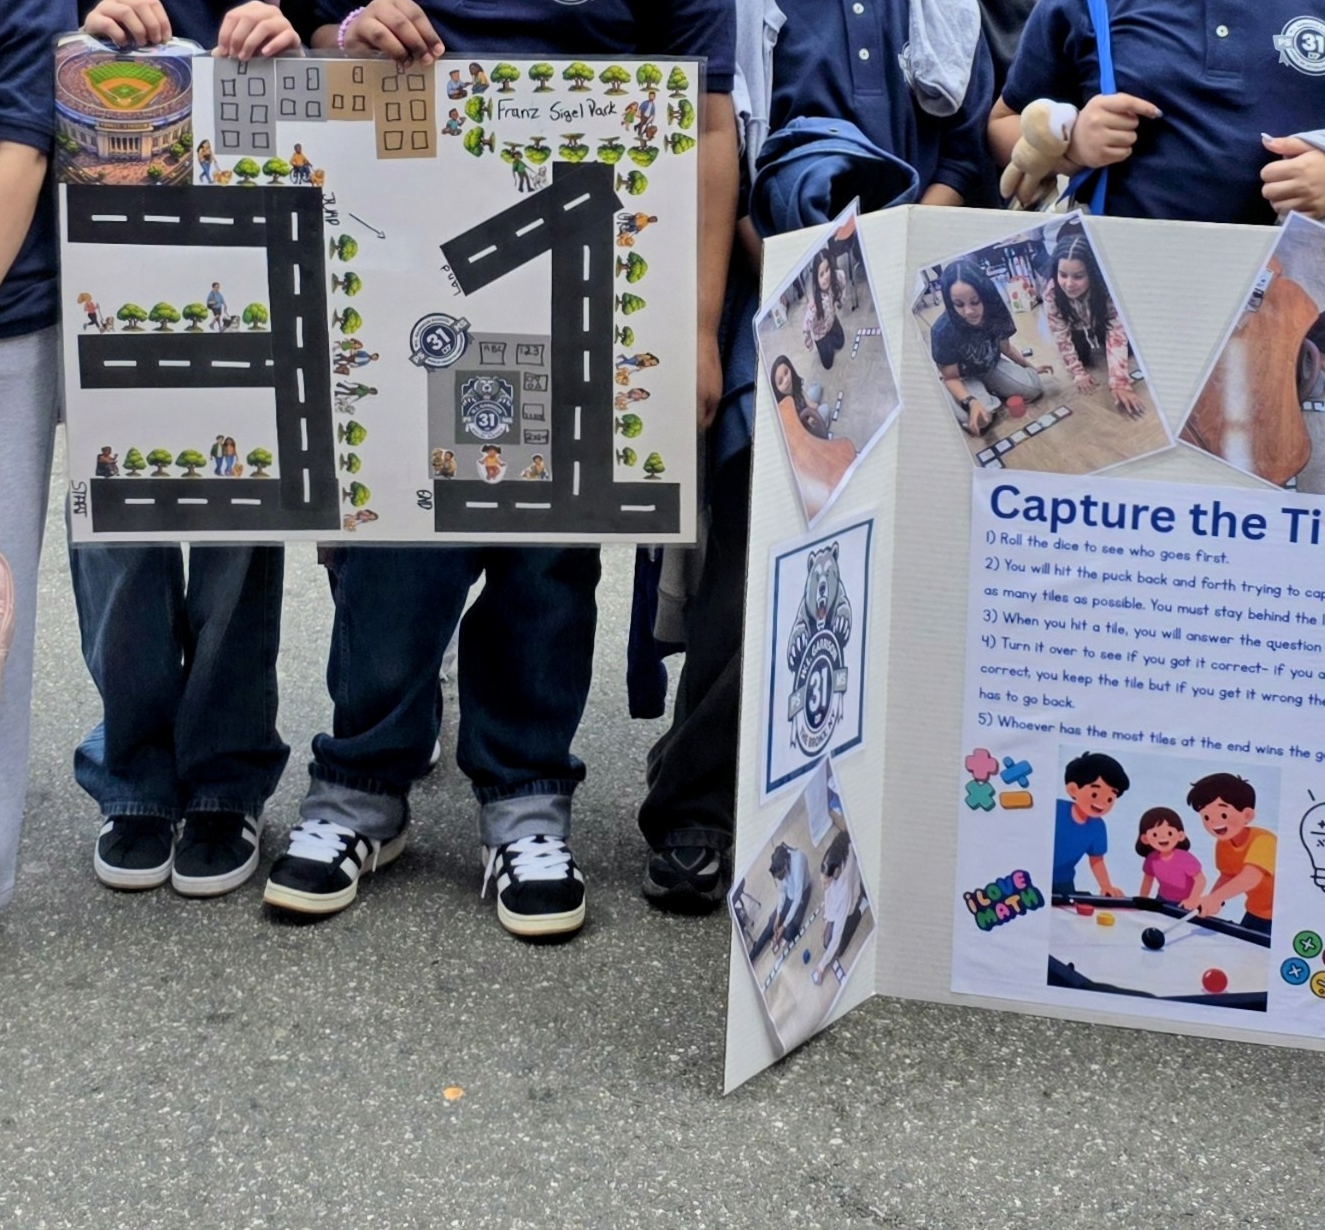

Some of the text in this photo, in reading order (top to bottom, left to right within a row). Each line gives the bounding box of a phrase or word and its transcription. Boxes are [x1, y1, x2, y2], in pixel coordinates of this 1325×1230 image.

[1301, 32, 1325, 54] 31
[497, 98, 618, 123] Franz Sigel Park
[440, 263, 462, 297] Land
[426, 327, 451, 351] 31
[483, 344, 503, 354] ABC
[520, 345, 540, 356] 123
[478, 413, 495, 427] 31
[990, 484, 1176, 533] Capture
[1188, 500, 1267, 541] the
[986, 529, 1229, 564] 1) Roll the dice to see who goes first.
[985, 556, 1000, 571] 2)
[1004, 558, 1026, 572] You
[1030, 562, 1050, 574] will
[1054, 563, 1072, 576] hit
[1076, 566, 1098, 580] the
[1102, 569, 1132, 583] puck
[1137, 570, 1167, 585] back
[1172, 575, 1196, 588] and
[1201, 576, 1236, 591] forth
[1240, 580, 1282, 598] trying
[1286, 584, 1300, 597] to
[983, 587, 998, 596] as
[1002, 589, 1037, 603] many
[1042, 589, 1069, 603] tiles
[1073, 596, 1088, 605] as
[1091, 596, 1145, 610] possible.
[1150, 598, 1172, 612] You
[1176, 604, 1210, 616] must
[1214, 605, 1243, 622] stay
[1247, 607, 1290, 623] behind
[1294, 611, 1317, 625] the
[982, 608, 1322, 652] 3) When you hit a tile, you will answer the question
[811, 638, 838, 662] GARRISON
[981, 634, 996, 649] 4)
[1000, 636, 1030, 651] Turn
[1034, 641, 1044, 653] it
[1049, 646, 1077, 656] over
[1082, 646, 1095, 658] to
[1100, 651, 1122, 661] see
[1126, 649, 1138, 662] if
[1142, 655, 1165, 666] you
[1170, 655, 1191, 669] got
[1195, 657, 1206, 668] it
[1210, 662, 1268, 674] correct-
[1273, 662, 1285, 676] if
[1289, 669, 1313, 680] you
[808, 666, 828, 712] 31
[835, 672, 846, 687] MS
[980, 665, 1031, 679] correct,
[1036, 671, 1058, 682] you
[1062, 669, 1093, 687] keep
[1098, 673, 1119, 687] the
[1124, 676, 1144, 689] tile
[1148, 678, 1171, 692] but
[1175, 680, 1187, 693] if
[1191, 686, 1214, 698] you
[1218, 687, 1241, 701] get
[1246, 688, 1256, 700] it
[1260, 693, 1303, 707] wrong
[791, 692, 801, 709] PS
[978, 687, 1074, 708] has to go back.
[800, 726, 809, 746] THE
[978, 711, 993, 727] 5)
[997, 714, 1055, 732] Whoever
[1059, 721, 1081, 735] has
[1086, 725, 1107, 738] the
[1112, 730, 1144, 742] most
[1149, 731, 1176, 746] tiles
[1180, 735, 1195, 747] at
[1200, 736, 1222, 750] the
[1226, 740, 1250, 753] end
[1255, 744, 1284, 756] wins
[1288, 745, 1311, 758] the
[975, 870, 1028, 907] LOVE
[975, 886, 1042, 930] MATH
